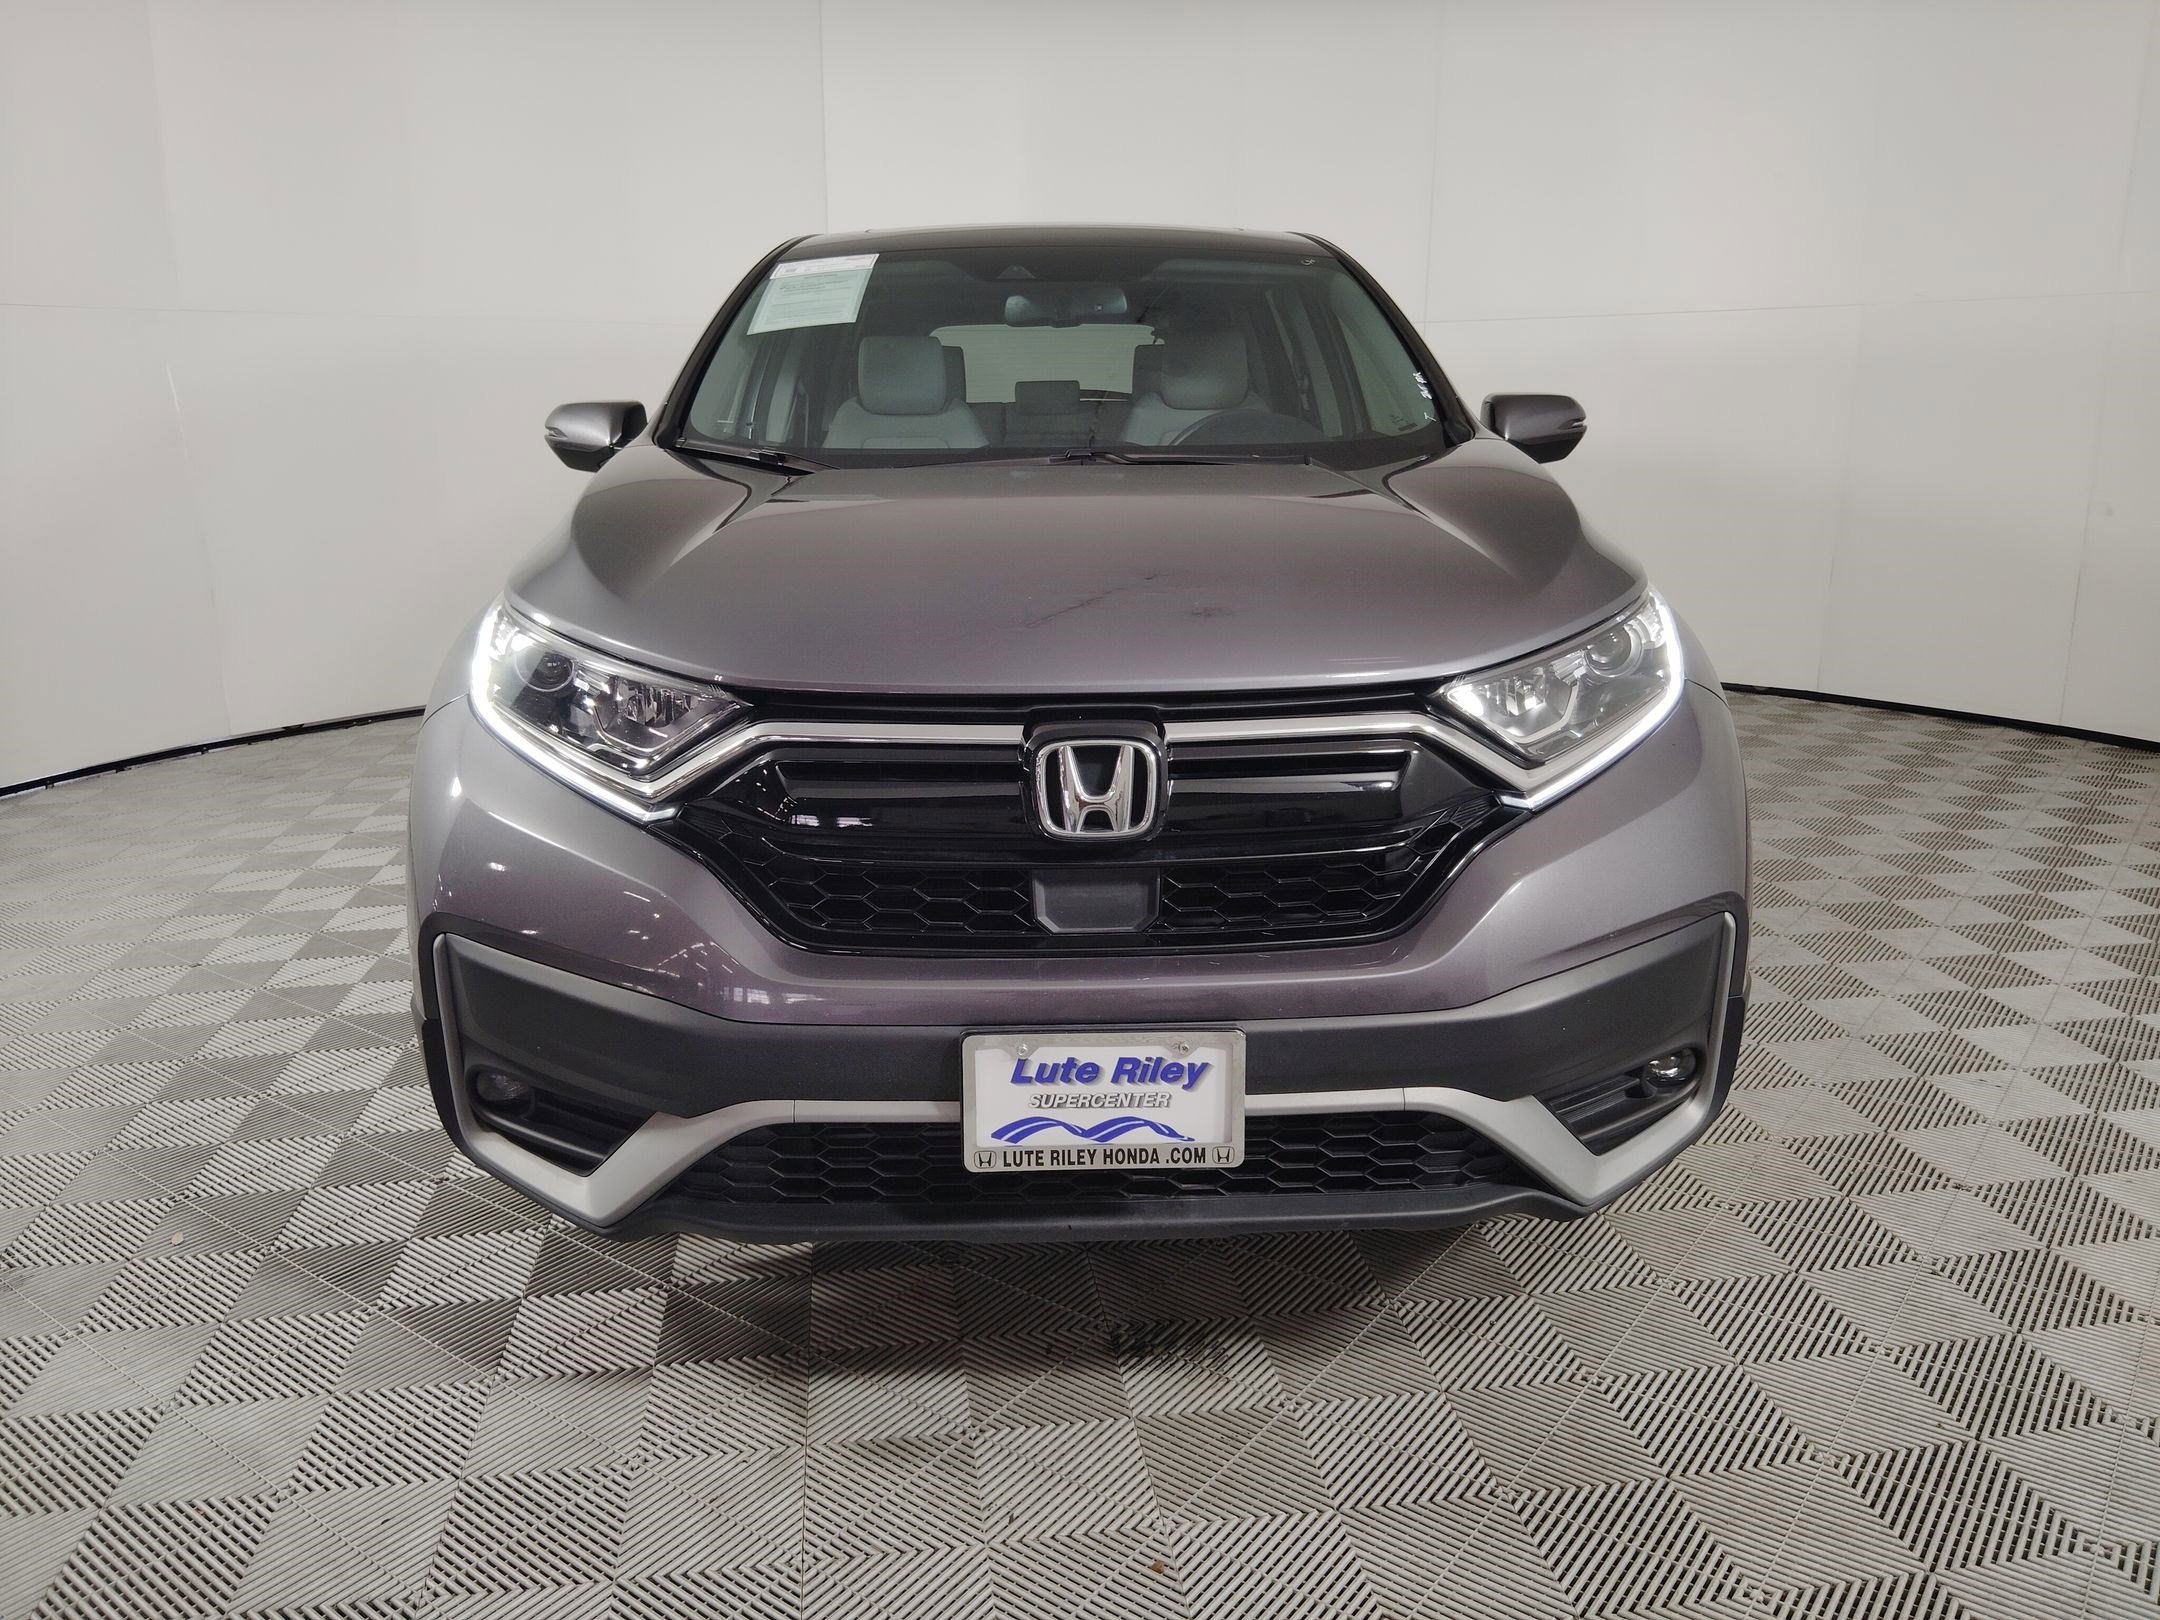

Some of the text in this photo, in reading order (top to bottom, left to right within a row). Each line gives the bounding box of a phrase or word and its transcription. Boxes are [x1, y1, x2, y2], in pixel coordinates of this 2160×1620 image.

[1010, 1056, 1210, 1090] Lute Riley
[1028, 1091, 1172, 1109] SUPERCENTER
[1003, 1150, 1045, 1167] LUTE
[1050, 1149, 1098, 1167] RILEY
[1103, 1148, 1160, 1166] HONDA
[1165, 1147, 1206, 1165] .COM
